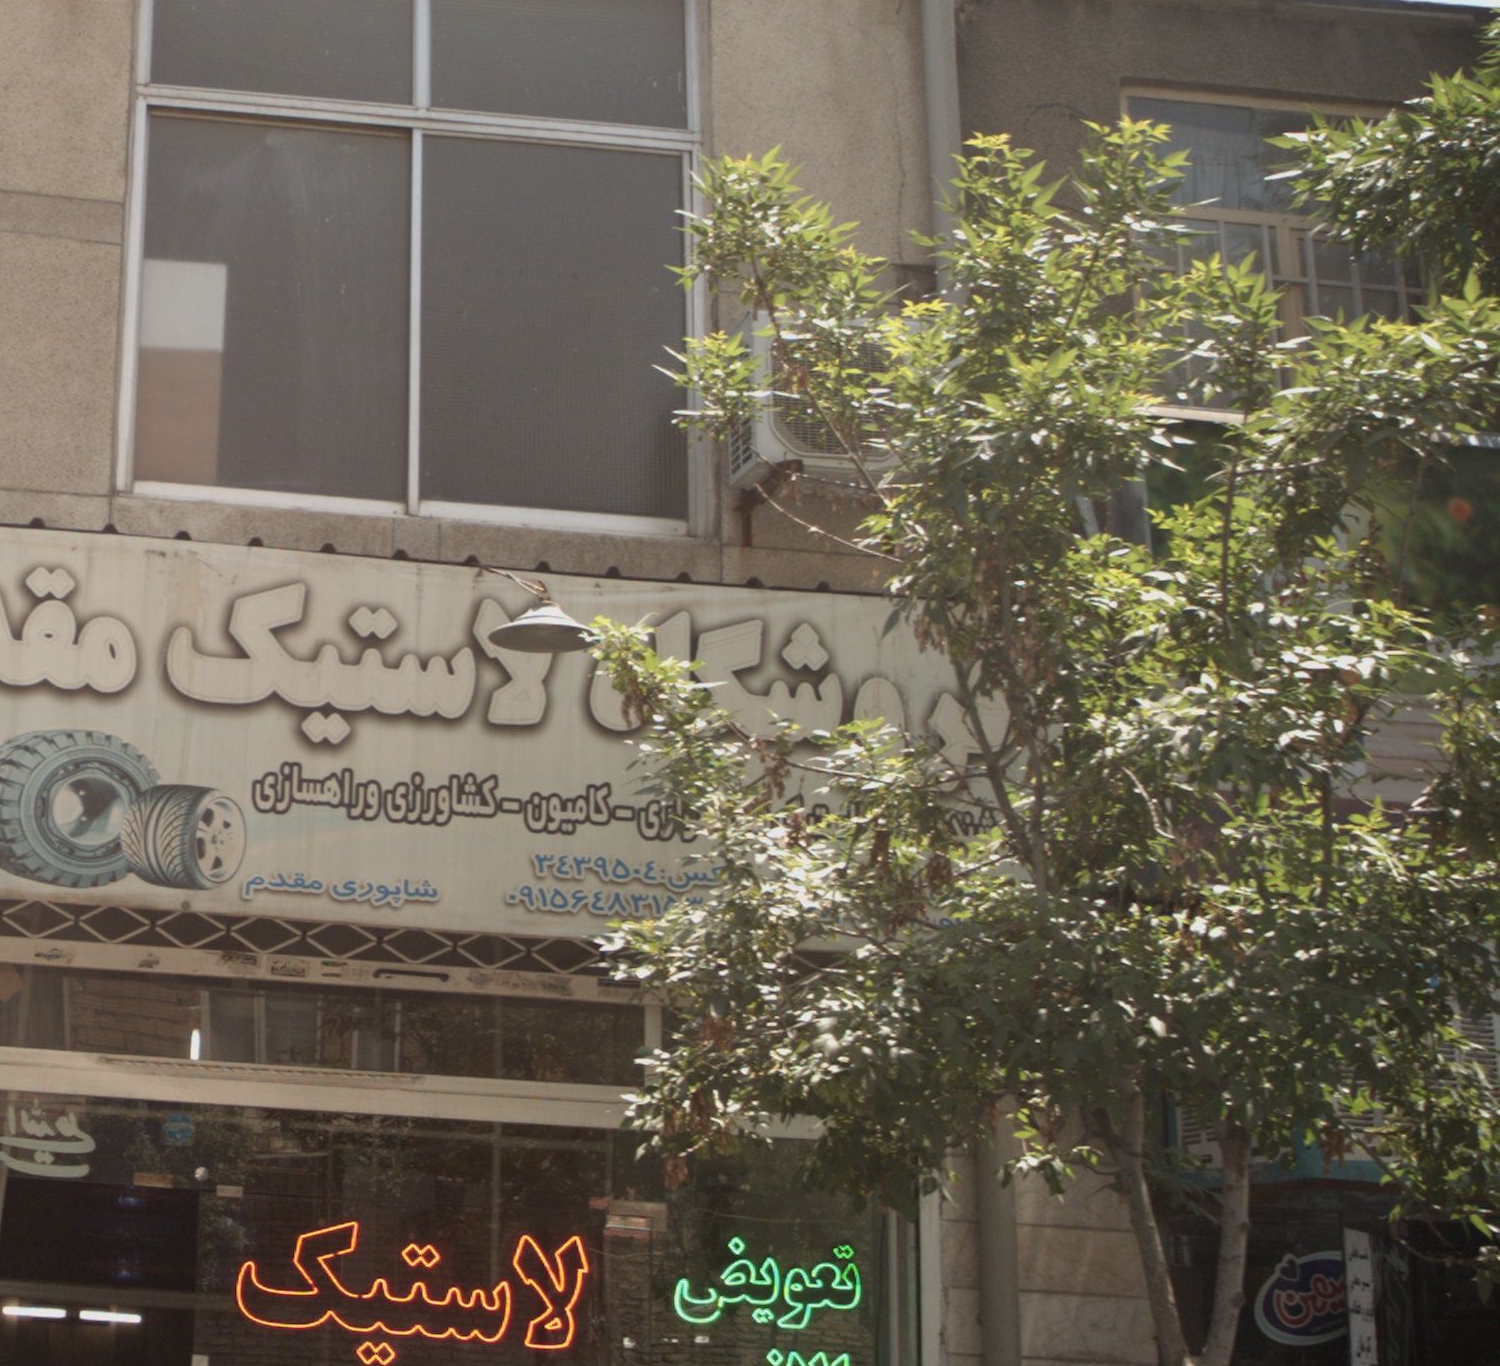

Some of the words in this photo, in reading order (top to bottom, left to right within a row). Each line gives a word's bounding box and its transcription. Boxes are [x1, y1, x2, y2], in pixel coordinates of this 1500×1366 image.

[384, 772, 498, 825] کشاورزی
[523, 782, 612, 833] کامیون
[243, 871, 325, 899] مقدم
[330, 878, 439, 904] شاپوری
[236, 1220, 589, 1366] لاستیک
[673, 1235, 862, 1330] تعویض
[1272, 1273, 1346, 1329] یهن
